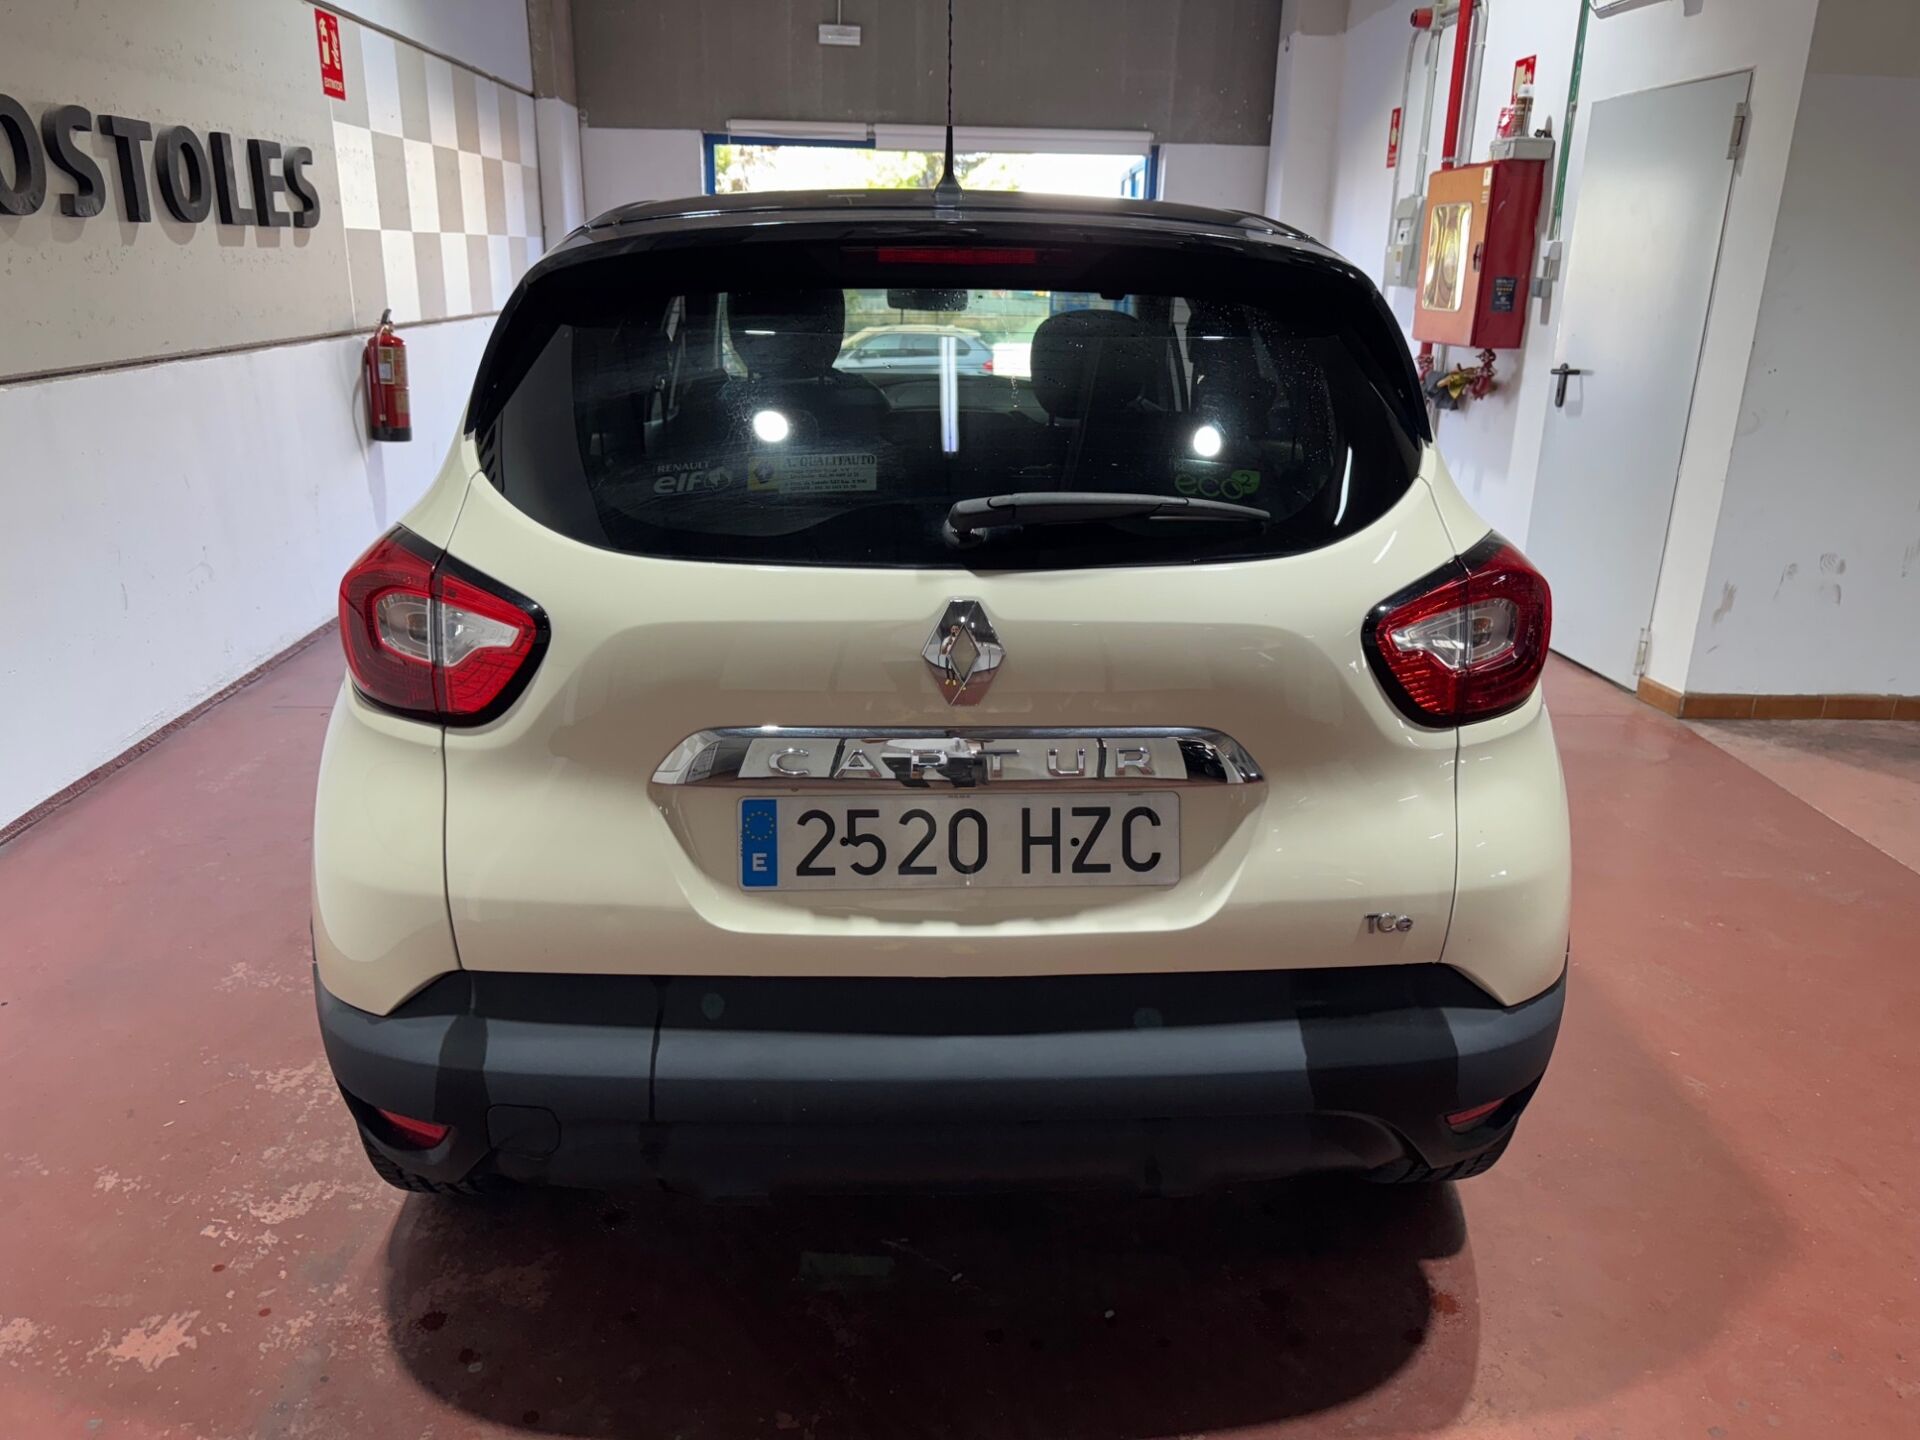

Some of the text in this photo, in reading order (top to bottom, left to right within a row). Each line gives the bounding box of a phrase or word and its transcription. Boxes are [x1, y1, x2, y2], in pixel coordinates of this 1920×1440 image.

[0, 93, 320, 228] OSTOLES
[657, 461, 710, 473] RENAULT
[768, 746, 1156, 779] CAPTUR
[796, 806, 1161, 877] 2520 HZC
[752, 852, 768, 872] E
[1364, 912, 1414, 934] TCe
